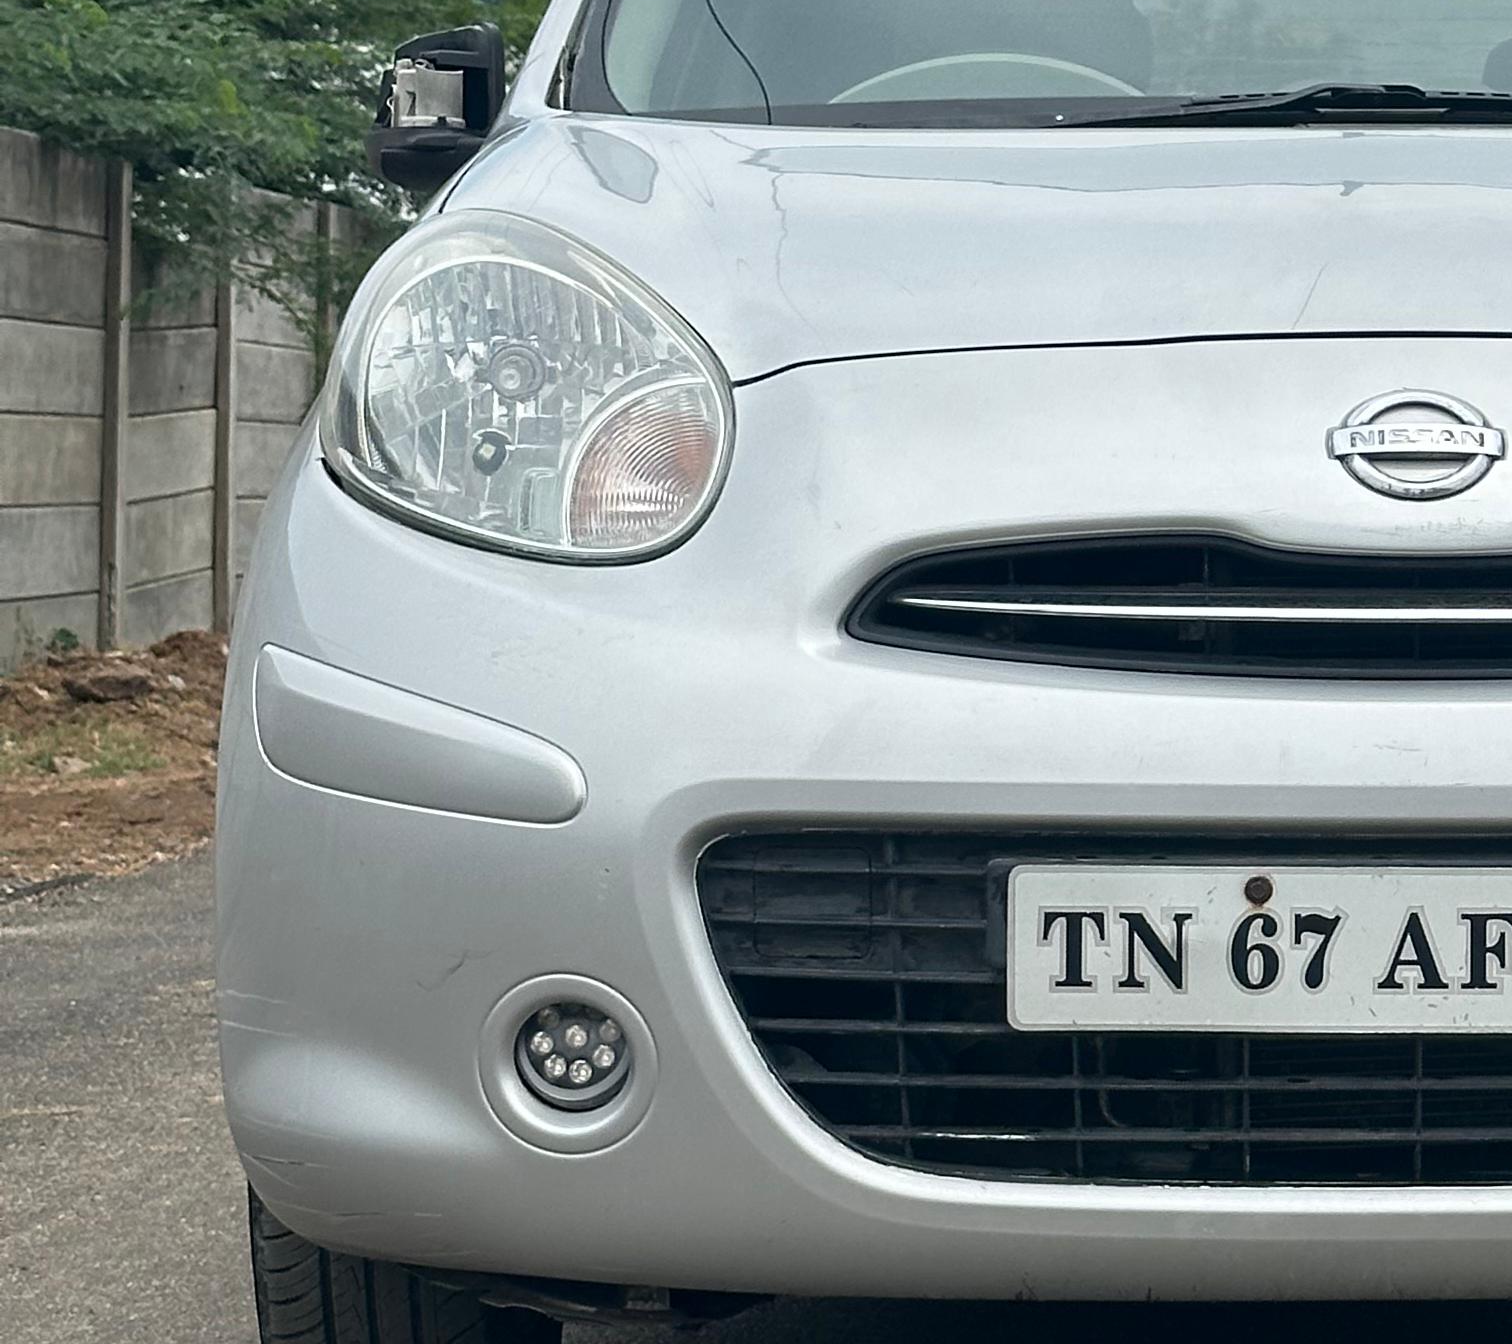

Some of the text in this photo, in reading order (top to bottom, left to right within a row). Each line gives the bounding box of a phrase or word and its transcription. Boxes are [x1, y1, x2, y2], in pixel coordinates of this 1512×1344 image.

[1350, 429, 1485, 448] NISSAN
[1042, 911, 1194, 990] TN
[1230, 911, 1342, 990] 67
